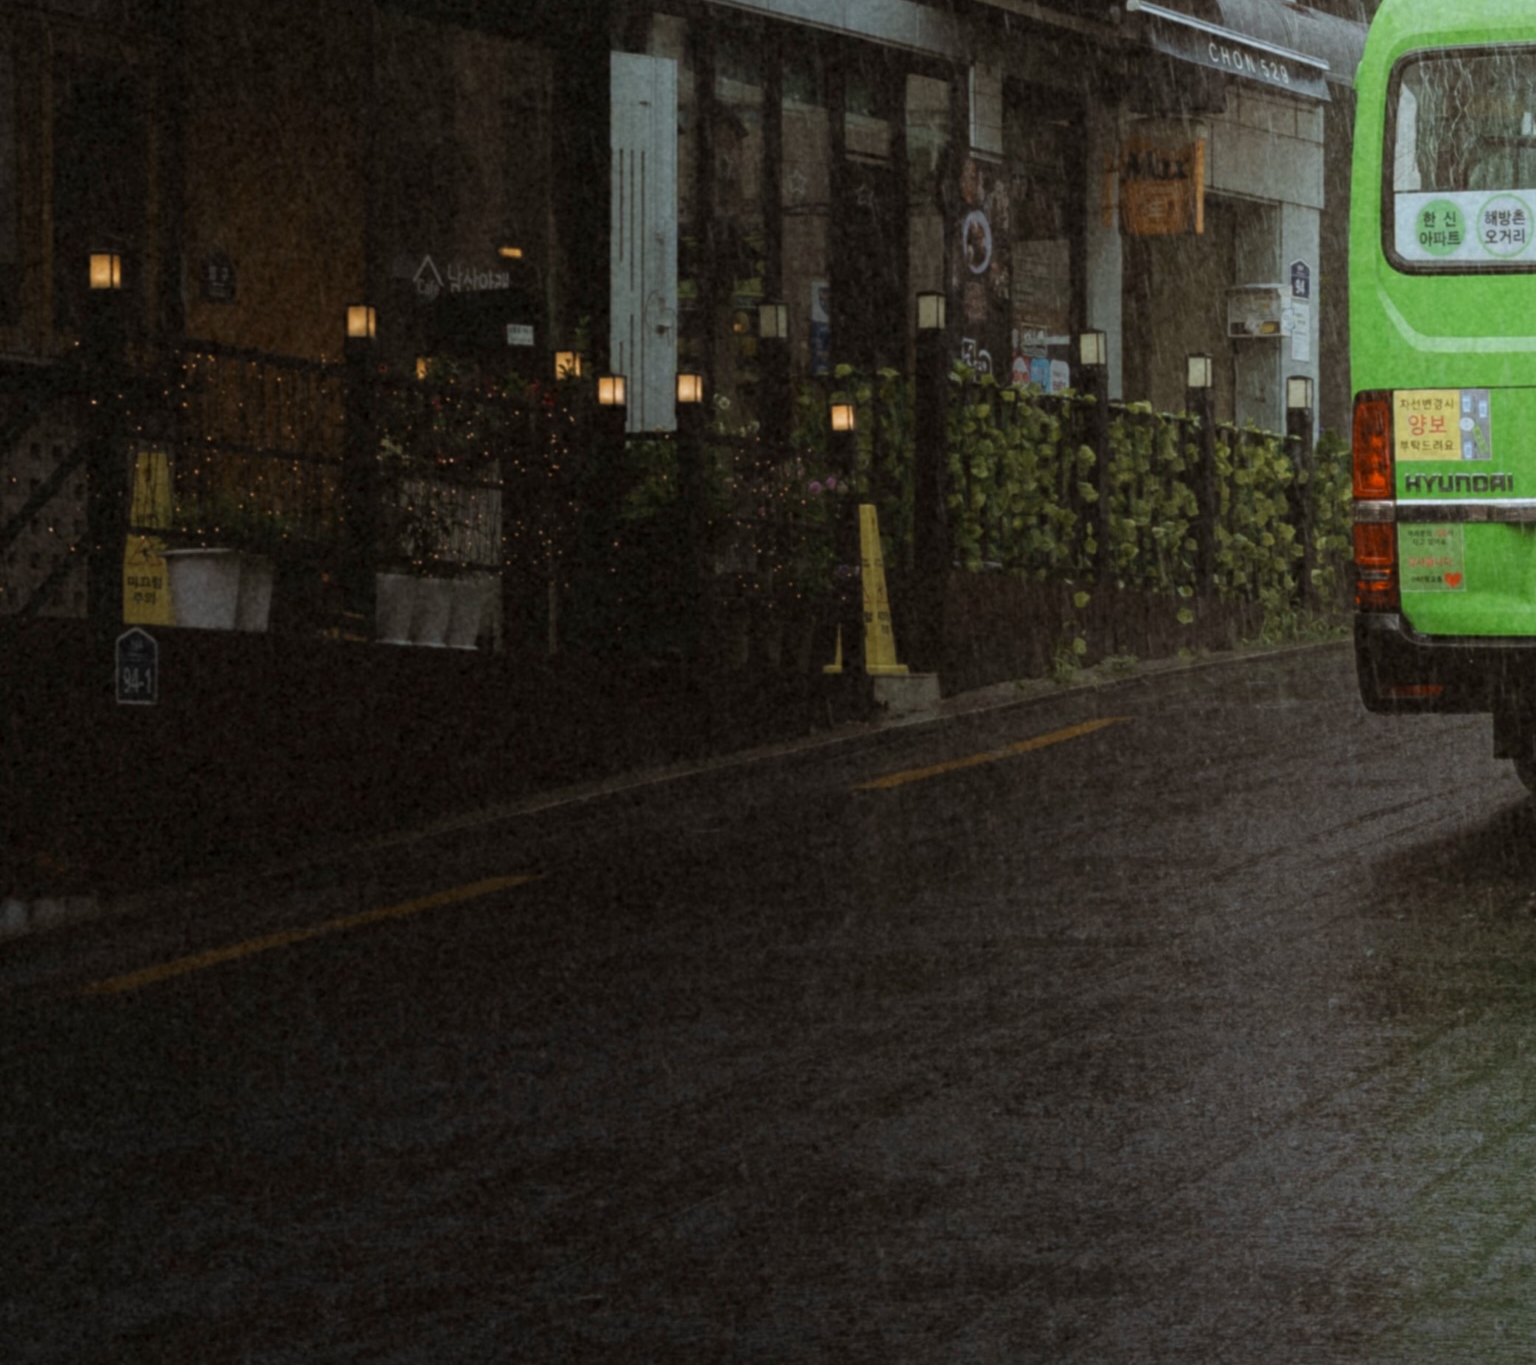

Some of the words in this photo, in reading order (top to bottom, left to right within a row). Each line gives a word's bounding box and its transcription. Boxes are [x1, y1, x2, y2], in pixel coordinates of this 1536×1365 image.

[1208, 41, 1256, 73] CHON
[1485, 209, 1526, 227] 해방촌
[1419, 230, 1462, 247] 아파트
[1485, 229, 1526, 245] 오거리
[1400, 398, 1455, 410] 차선변경시
[1408, 414, 1448, 436] 양보
[1404, 472, 1514, 493] HYUNDAI
